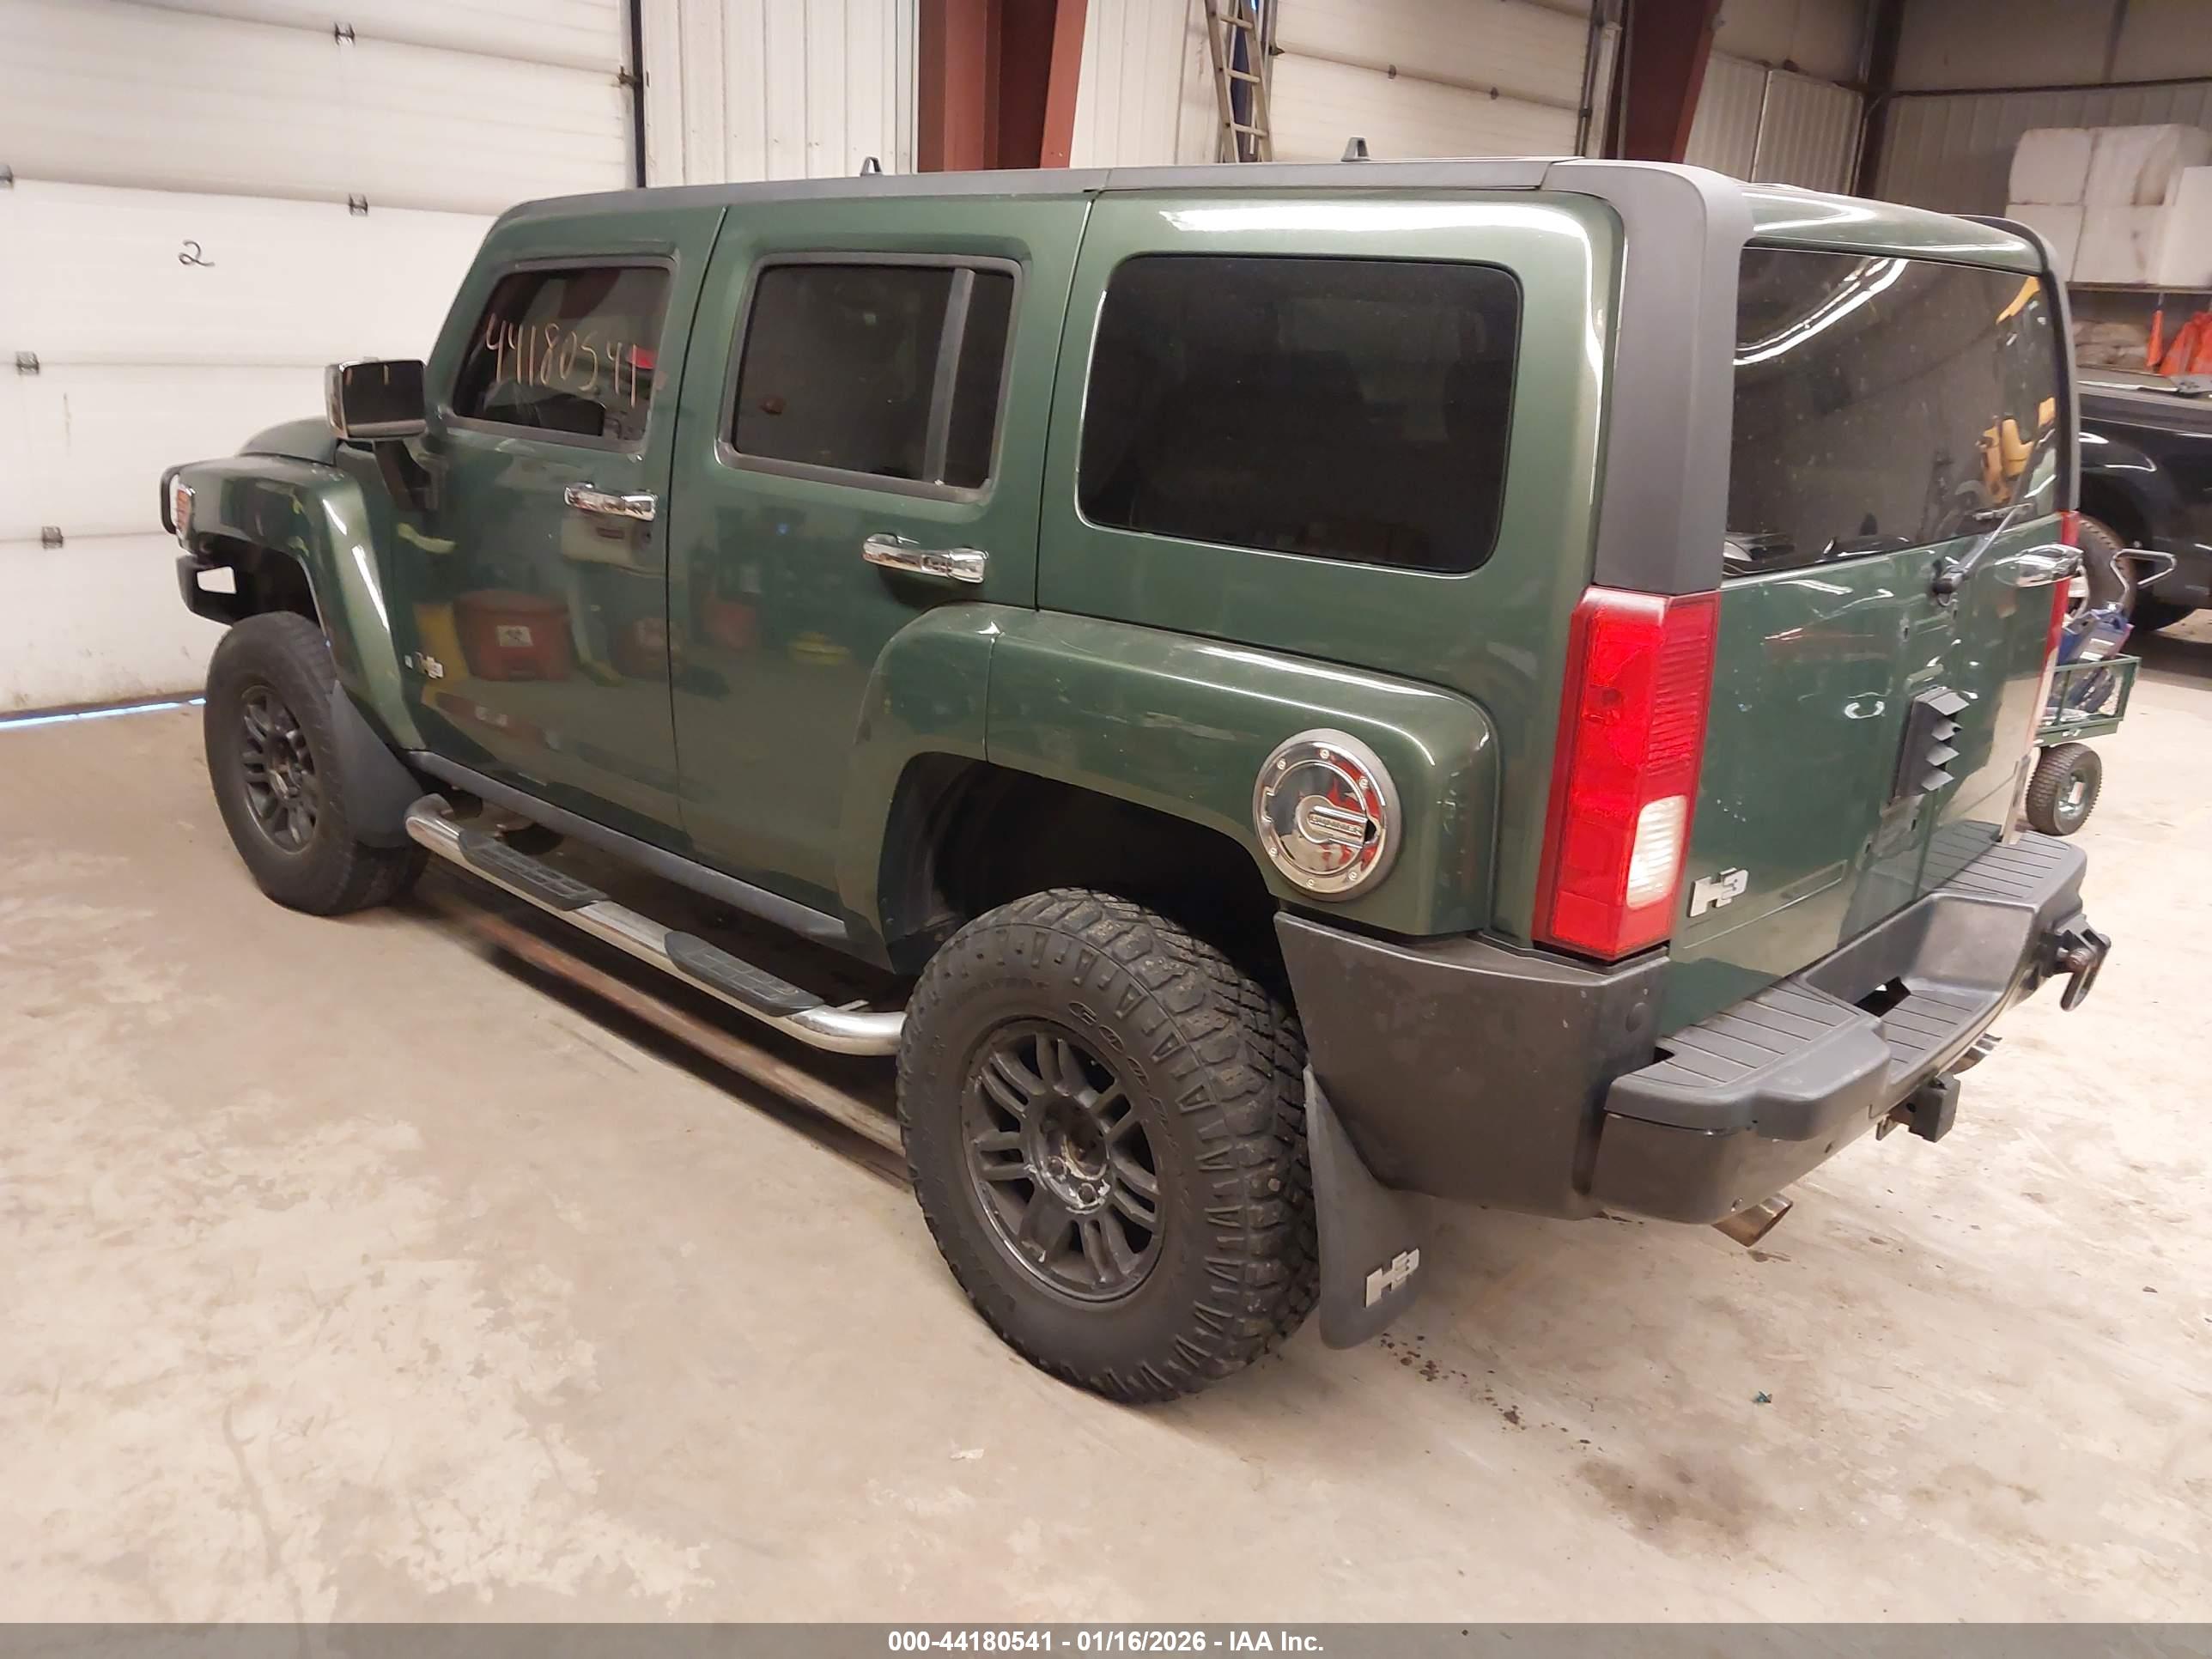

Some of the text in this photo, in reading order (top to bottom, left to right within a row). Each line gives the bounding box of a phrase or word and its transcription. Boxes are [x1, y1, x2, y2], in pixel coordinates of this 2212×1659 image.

[178, 240, 216, 267] 2
[486, 313, 637, 409] 44180541
[1688, 866, 1749, 918] H3
[1364, 1248, 1420, 1309] H3
